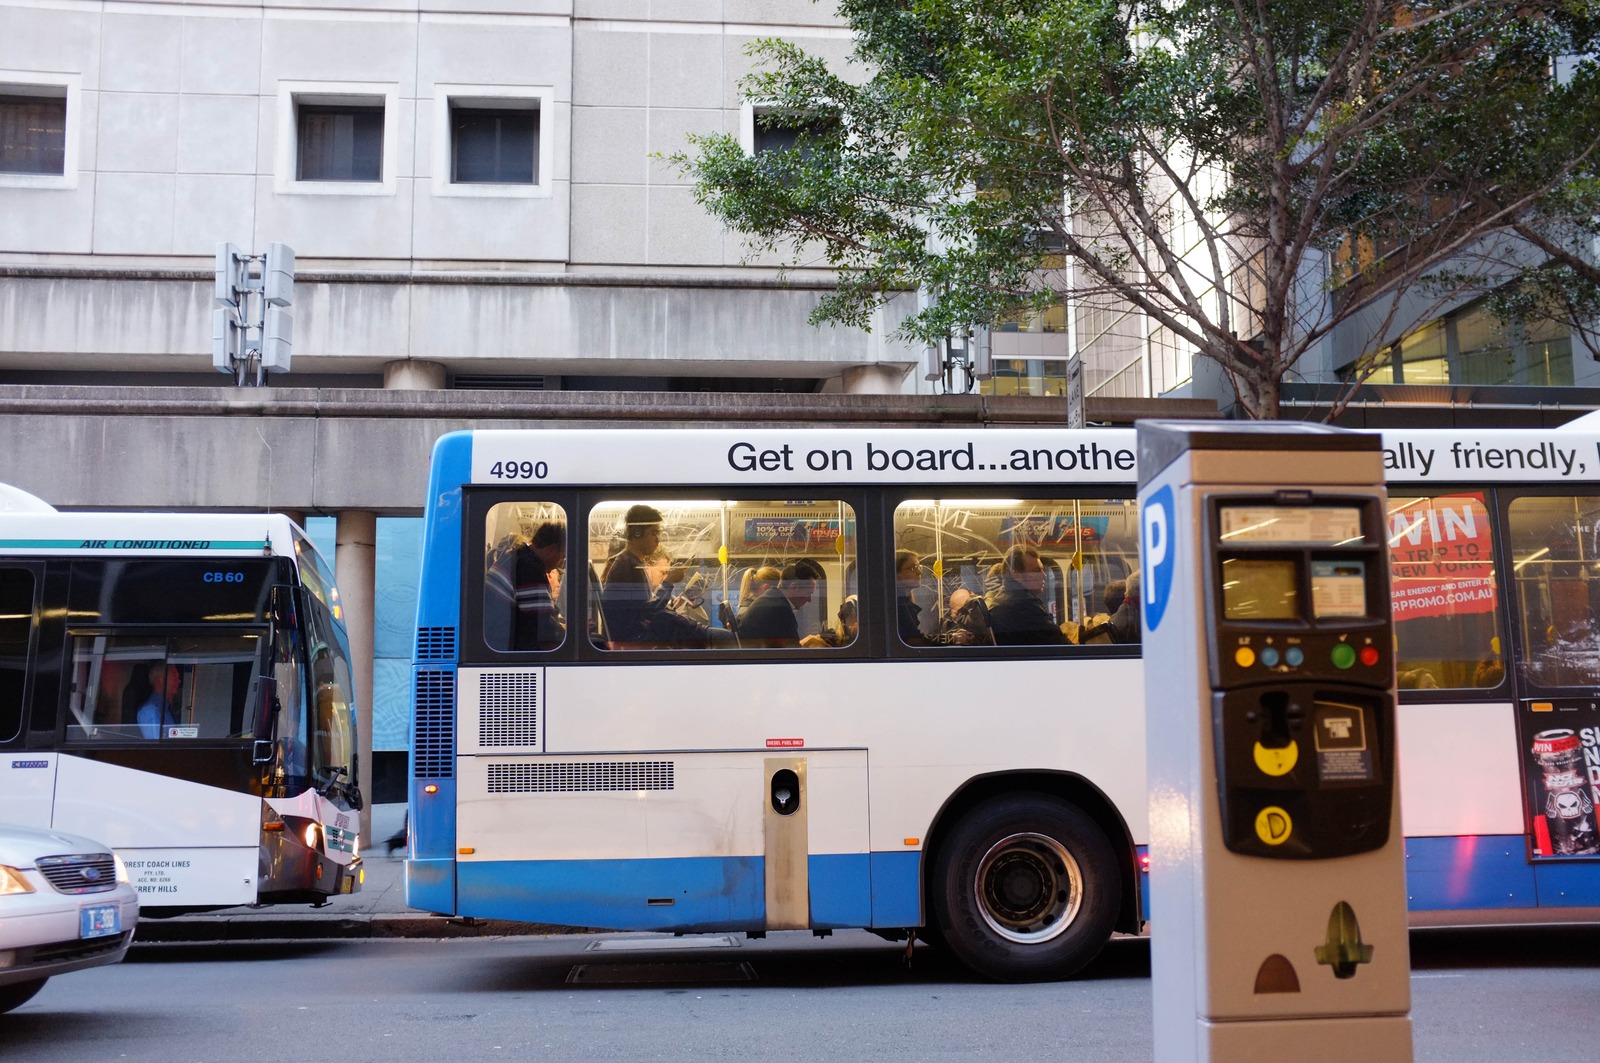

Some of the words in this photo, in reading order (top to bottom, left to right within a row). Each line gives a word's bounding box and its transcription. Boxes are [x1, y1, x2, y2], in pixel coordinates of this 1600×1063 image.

[727, 442, 794, 471] Get
[806, 449, 853, 471] on
[1383, 442, 1435, 476] ally
[1450, 442, 1586, 476] friendly,
[490, 461, 548, 479] 4990
[1387, 505, 1478, 548] WIN
[80, 540, 108, 549] AIR
[113, 540, 211, 549] CONDITIONED
[1145, 502, 1167, 605] P
[1405, 547, 1448, 562] TRIP
[1454, 543, 1479, 557] TO
[1441, 583, 1457, 591] AND
[1458, 580, 1482, 588] ENTER
[1534, 742, 1553, 752] WIN
